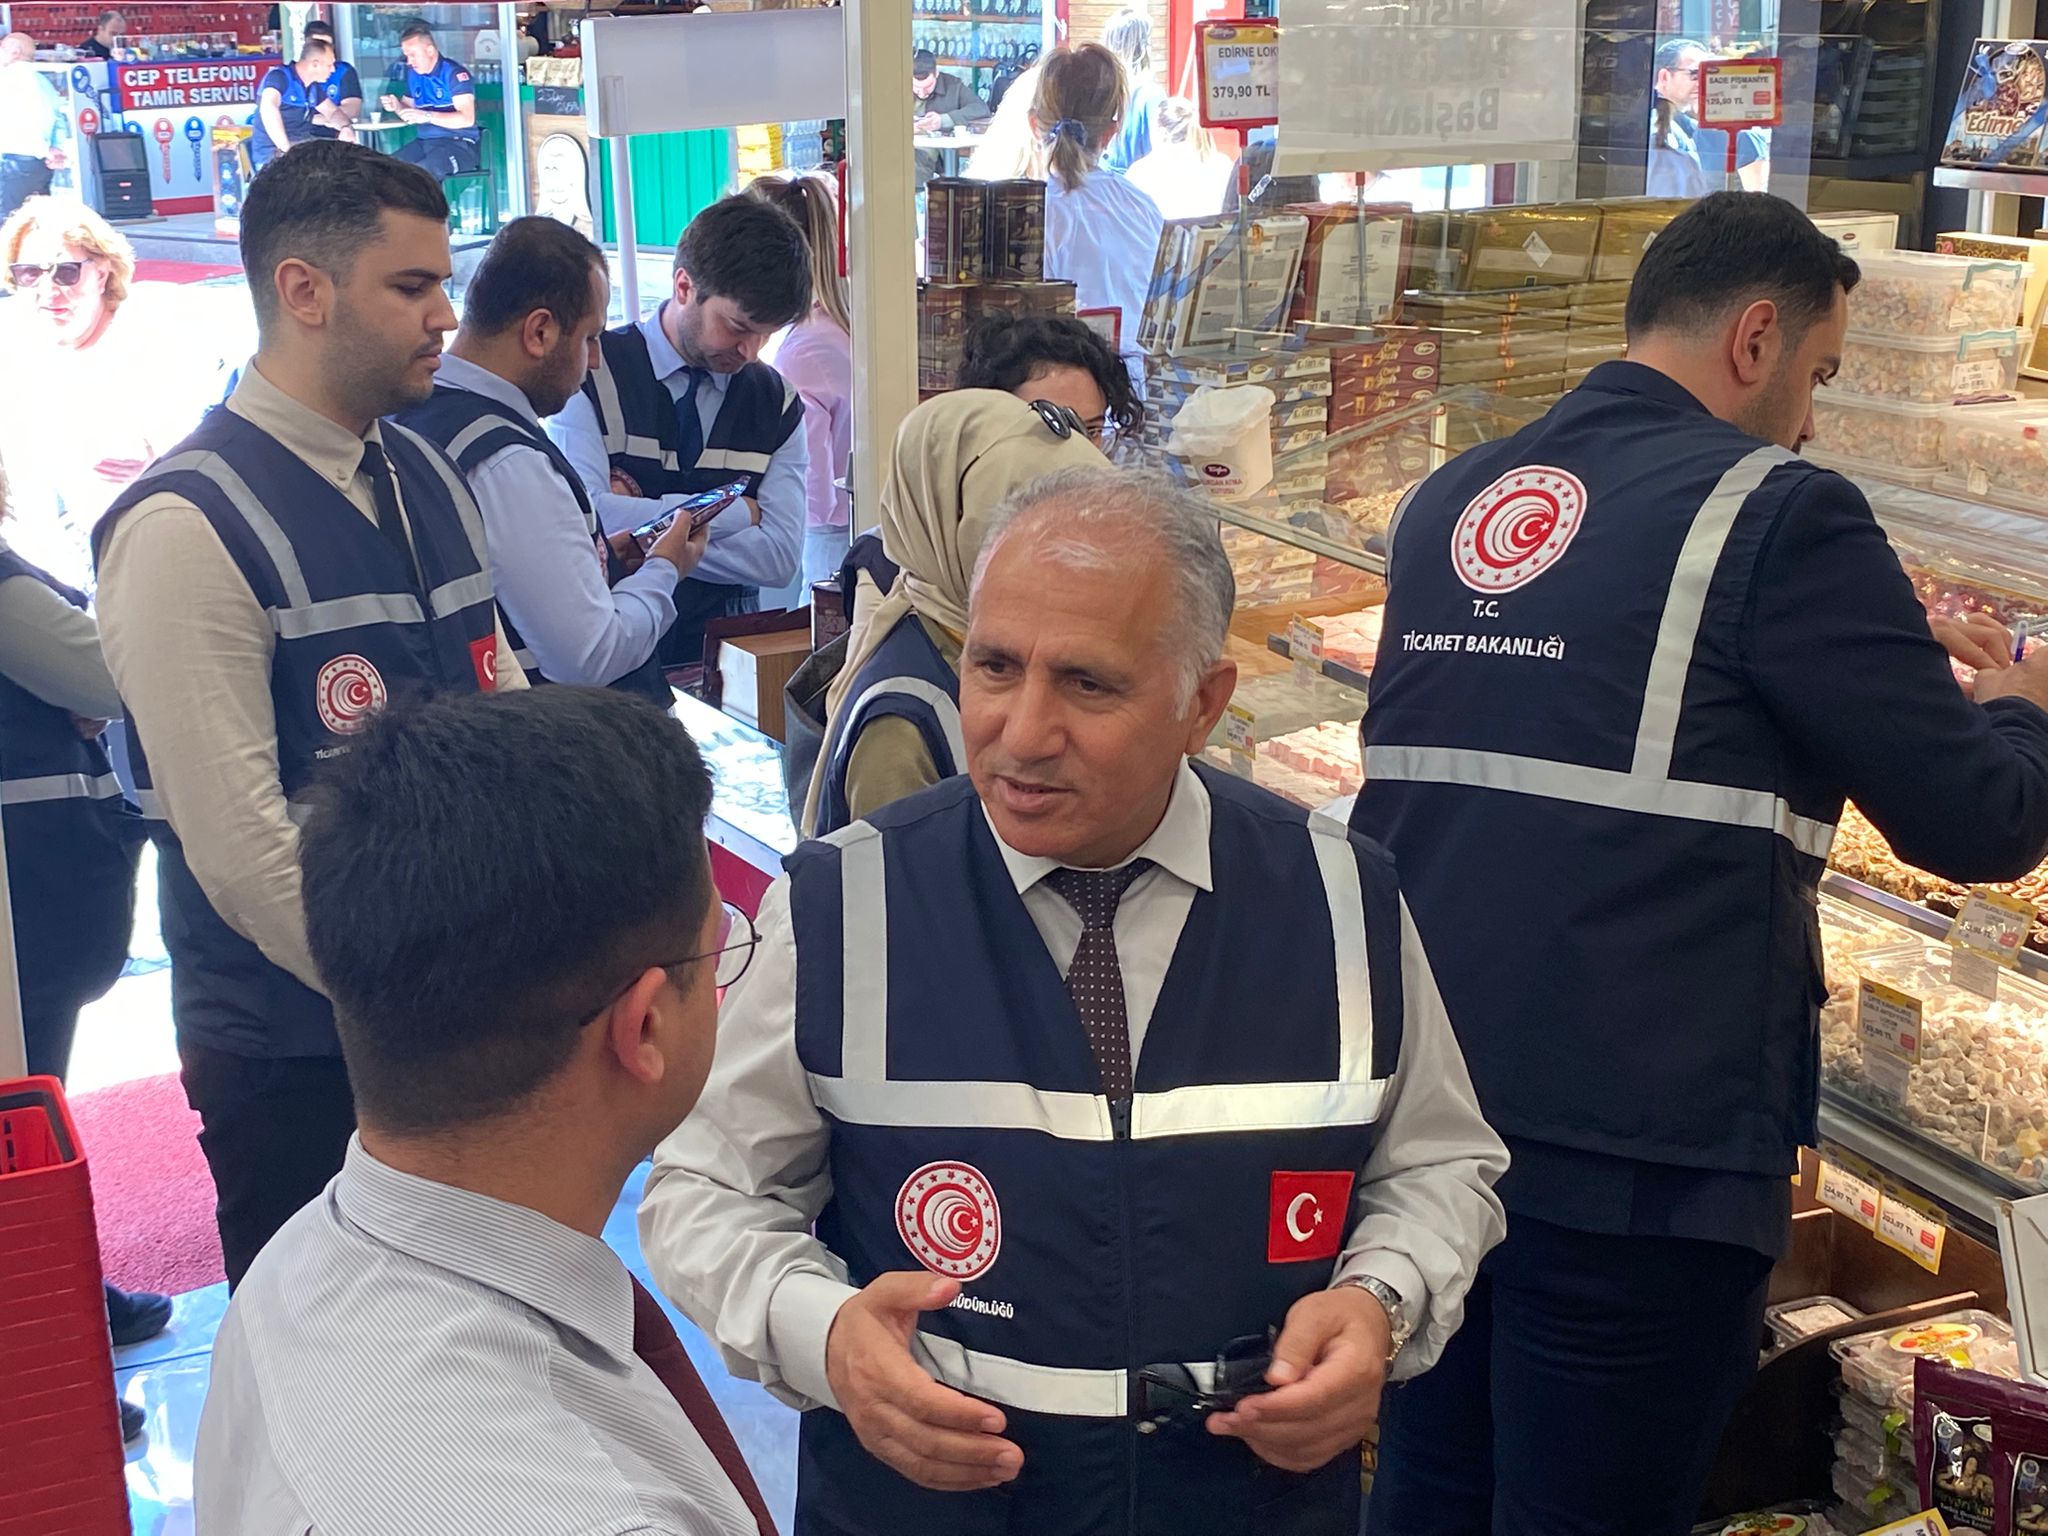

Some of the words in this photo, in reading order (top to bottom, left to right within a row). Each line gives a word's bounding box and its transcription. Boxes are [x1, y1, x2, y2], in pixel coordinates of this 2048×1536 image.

[1218, 45, 1255, 58] EDİRNE
[1257, 46, 1278, 57] LOK
[123, 69, 161, 87] CEP
[164, 65, 257, 85] TELEFONU
[129, 86, 187, 107] TAMİR
[189, 82, 255, 103] SERVİSİ
[1212, 85, 1252, 100] 379,90
[1256, 85, 1271, 97] TL
[1733, 97, 1744, 105] TL
[1472, 599, 1500, 618] T.C.
[1402, 630, 1464, 652] TİCARET
